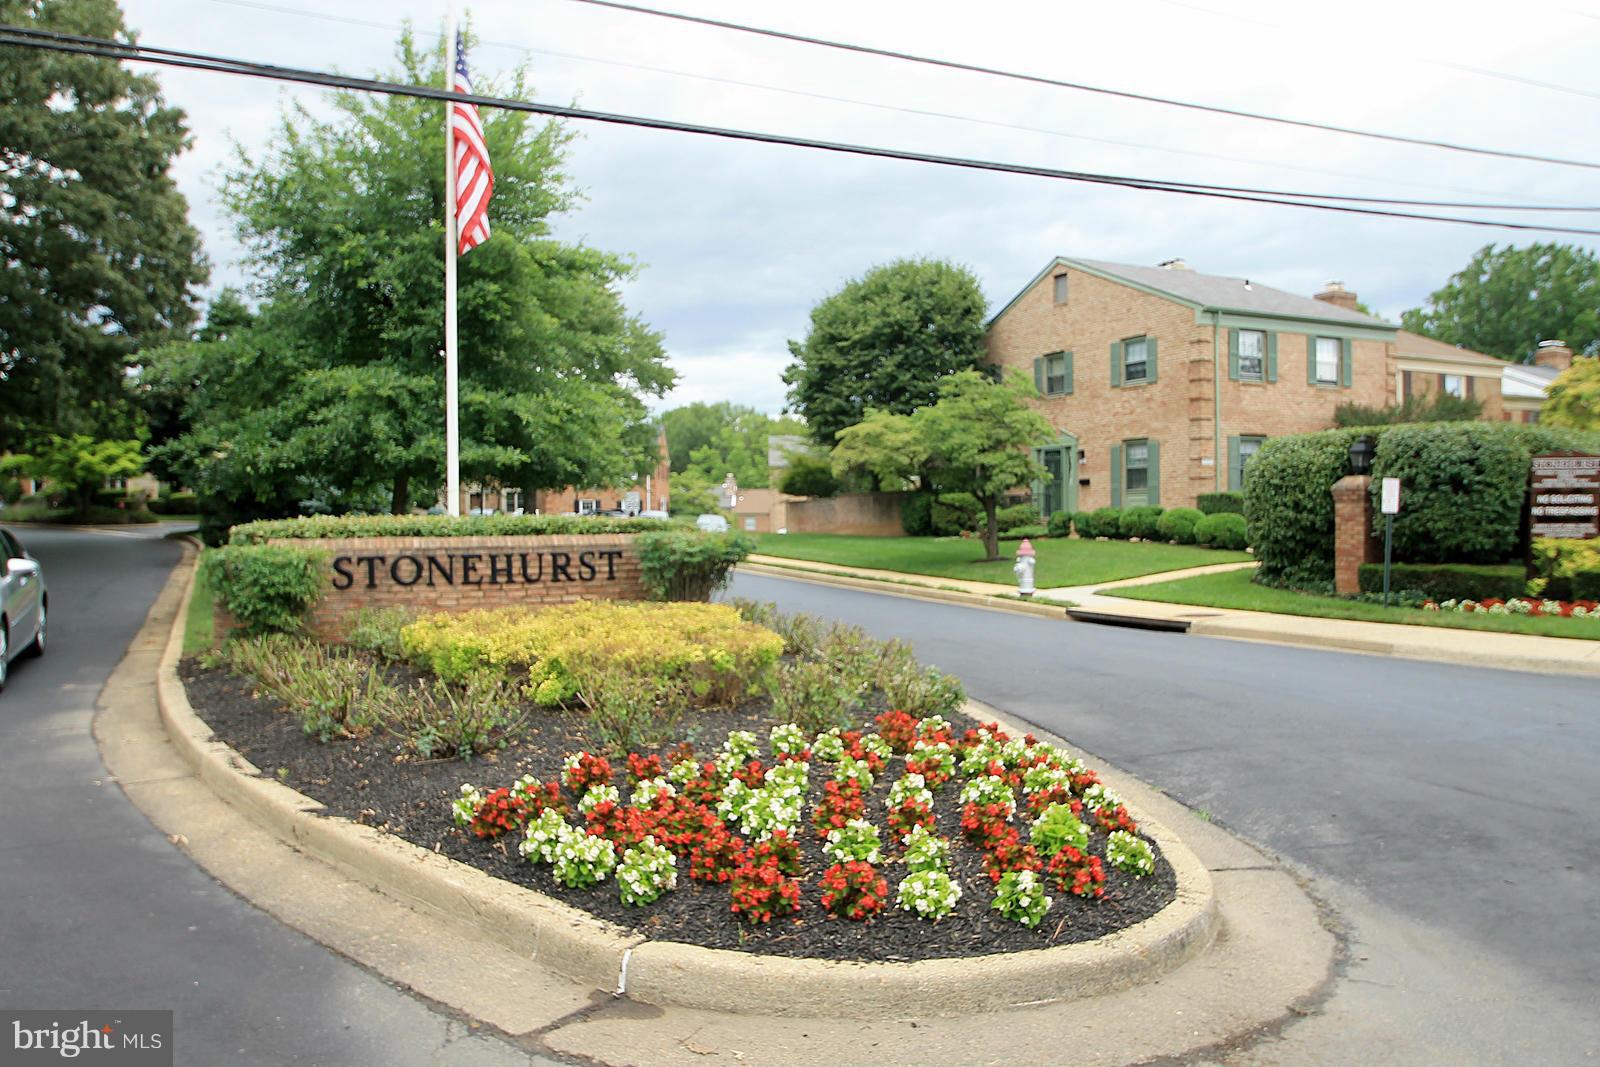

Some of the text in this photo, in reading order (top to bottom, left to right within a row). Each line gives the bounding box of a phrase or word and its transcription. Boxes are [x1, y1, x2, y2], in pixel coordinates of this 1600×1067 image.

[1536, 494, 1549, 504] NO
[1531, 506, 1544, 516] NO
[332, 550, 623, 590] STONEHURST
